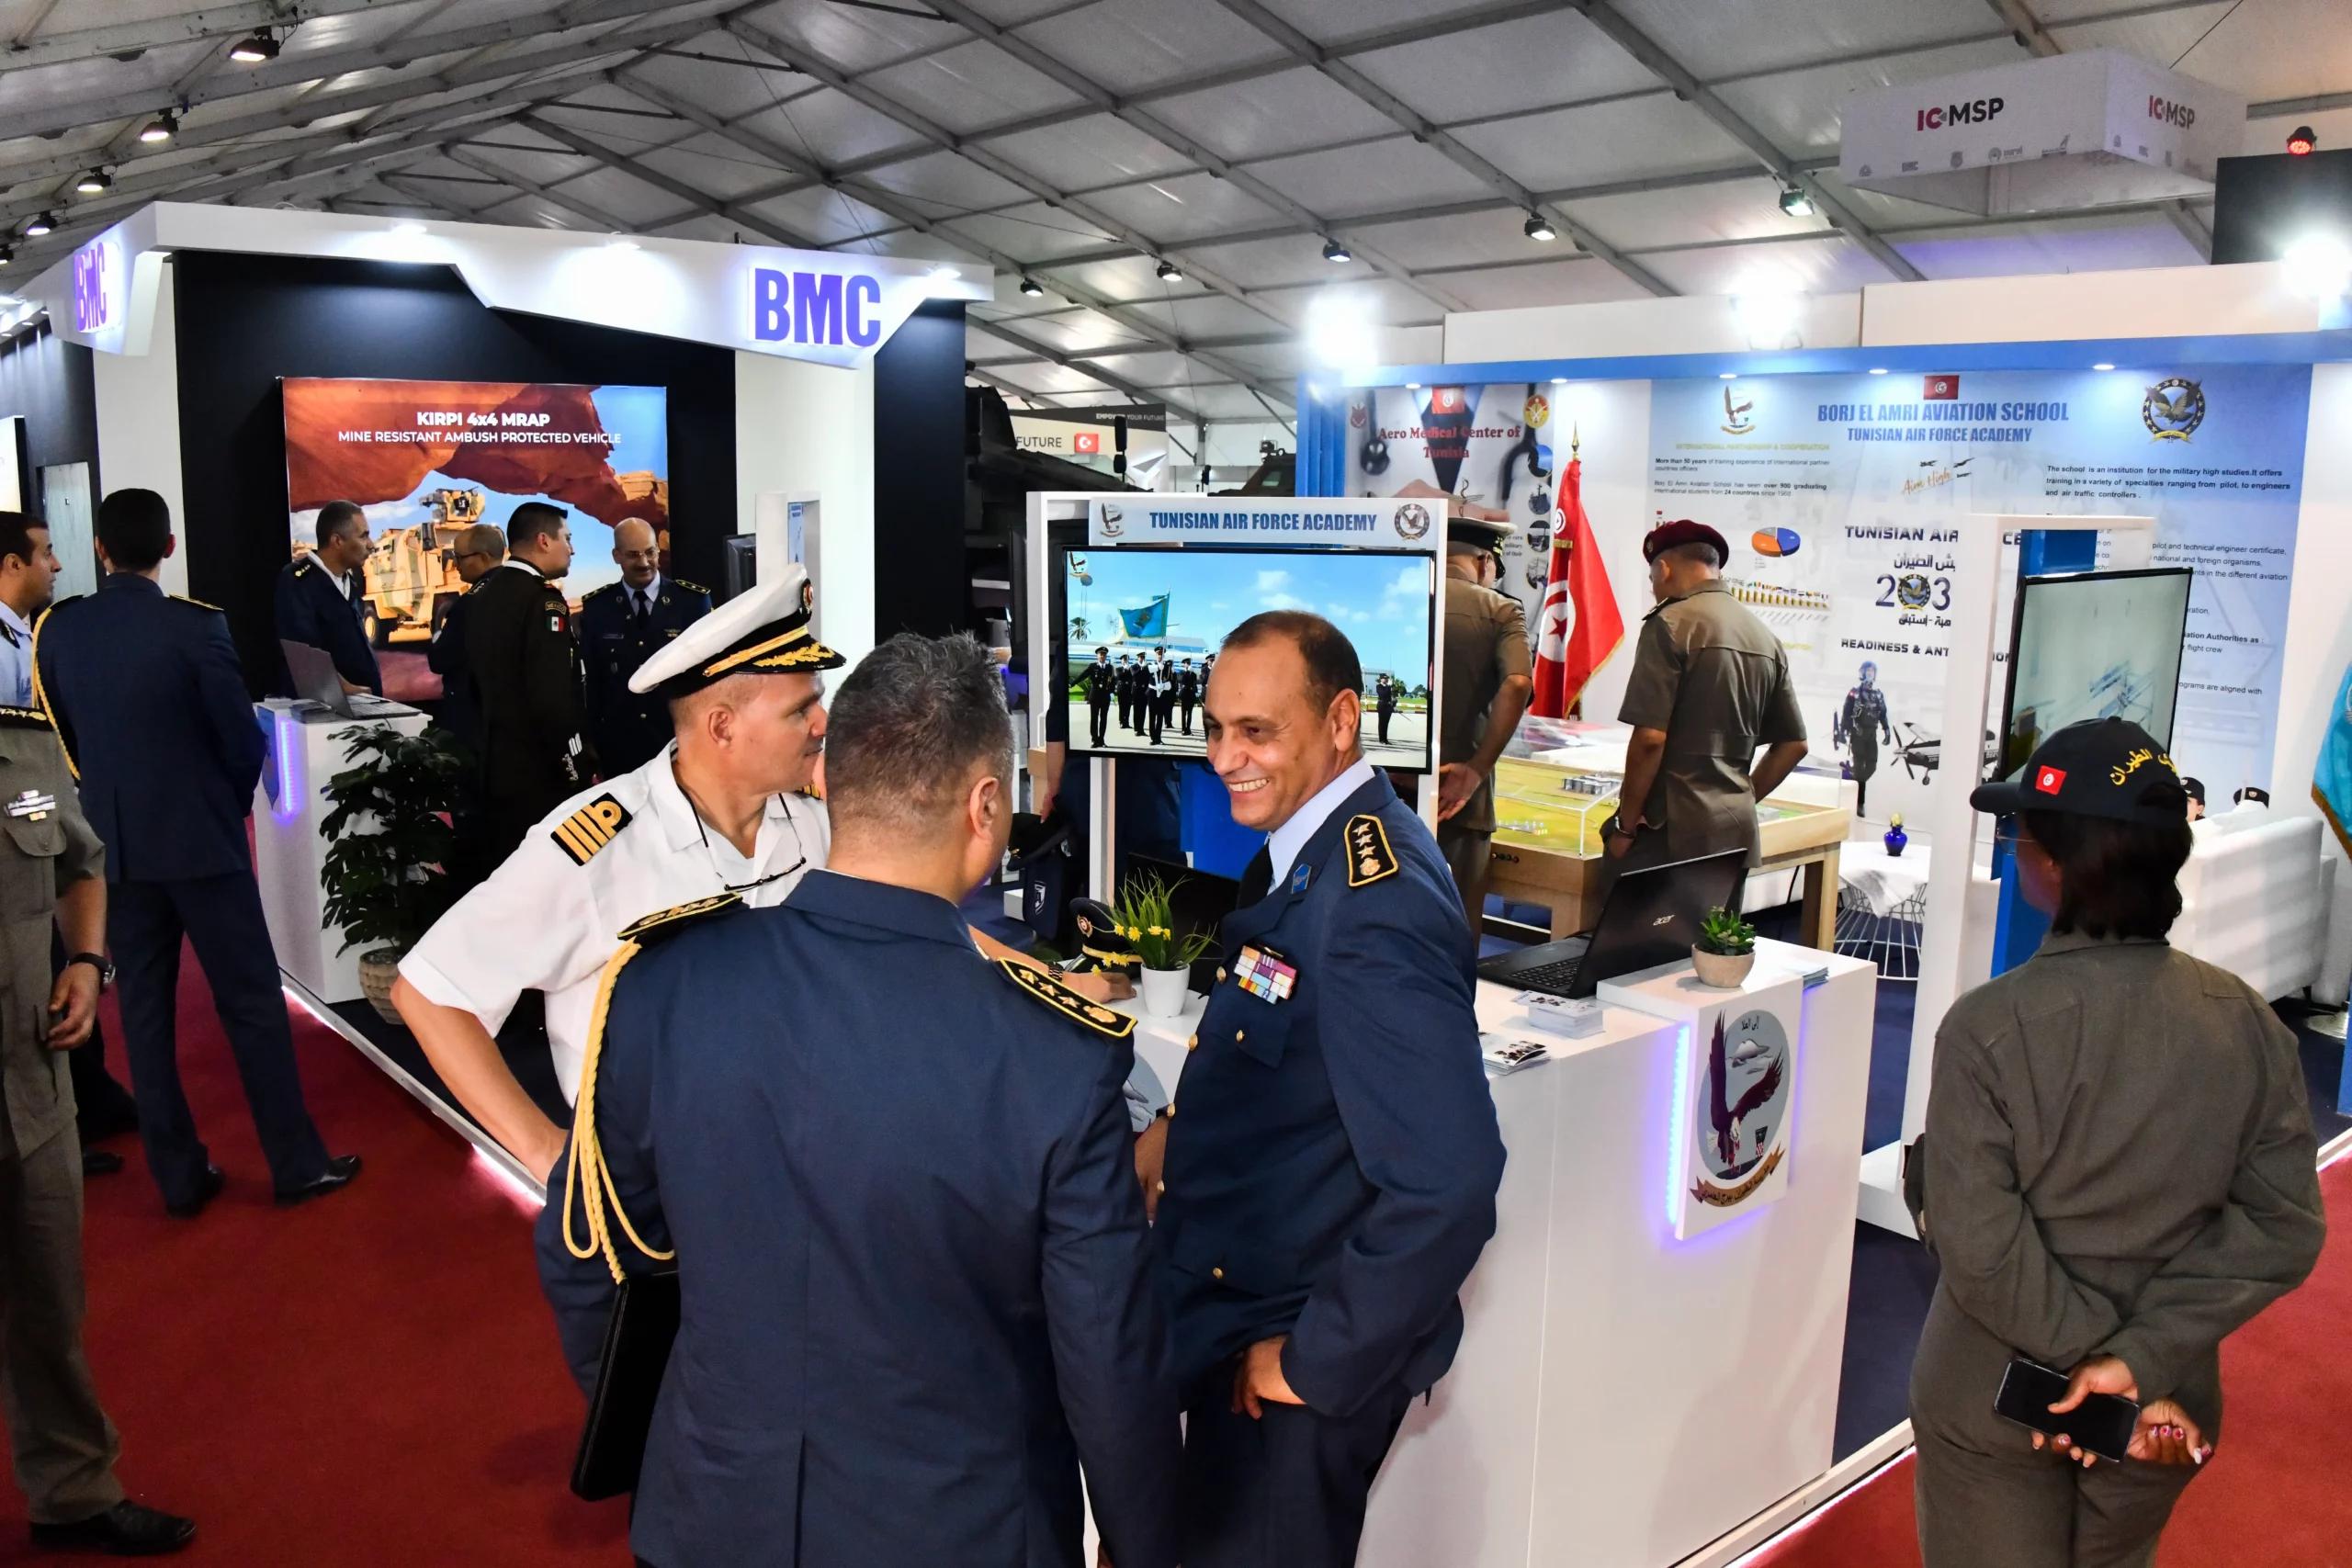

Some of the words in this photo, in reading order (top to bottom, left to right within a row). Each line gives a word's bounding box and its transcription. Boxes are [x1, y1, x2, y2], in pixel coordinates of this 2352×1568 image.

[74, 242, 107, 332] BMC
[755, 268, 881, 347] BMC
[1818, 404, 1855, 422] BORJ
[1859, 405, 1873, 421] EL
[1877, 404, 1918, 421] AMRI
[1922, 403, 1996, 421] AVIATION
[2001, 402, 2069, 421] SCHOOL
[417, 412, 463, 426] KIRPI
[467, 412, 498, 426] 4x4
[502, 413, 550, 427] MRAP
[338, 431, 372, 442] MINE
[375, 432, 441, 443] RESISTANT
[444, 432, 498, 443] AMBUSH
[502, 433, 571, 444] PROTECTED
[573, 434, 621, 444] VEHICLE
[1378, 428, 1407, 439] Aero
[1409, 426, 1457, 439] Medical
[1462, 426, 1504, 438] Center
[1507, 425, 1521, 437] of
[1848, 428, 1902, 442] TUNISIAN
[1905, 428, 1927, 442] AIR
[1929, 428, 1968, 442] FORCE
[1971, 428, 2032, 442] ACADEMY
[1016, 436, 1062, 448] FUTURE
[1423, 446, 1469, 458] Tunisia
[2173, 468, 2200, 476] military
[2203, 468, 2220, 477] high
[2046, 478, 2072, 486] training
[2088, 479, 2112, 487] variety
[2125, 479, 2164, 488] specialties
[2167, 480, 2196, 489] ranging
[1149, 512, 1219, 529] TUNISIAN
[1223, 513, 1249, 529] AIR
[1252, 513, 1299, 530] FORCE
[1303, 513, 1376, 531] ACADEMY
[1845, 525, 1924, 541] TUNISIAN
[1929, 529, 1958, 542] AIR
[2198, 557, 2222, 565] foreign
[2206, 633, 2247, 643] Authorities
[1841, 637, 1909, 653] READINESS
[1913, 645, 1920, 654] &
[2221, 684, 2246, 694] aligned
[2248, 687, 2263, 695] with
[1653, 914, 1676, 926] acer
